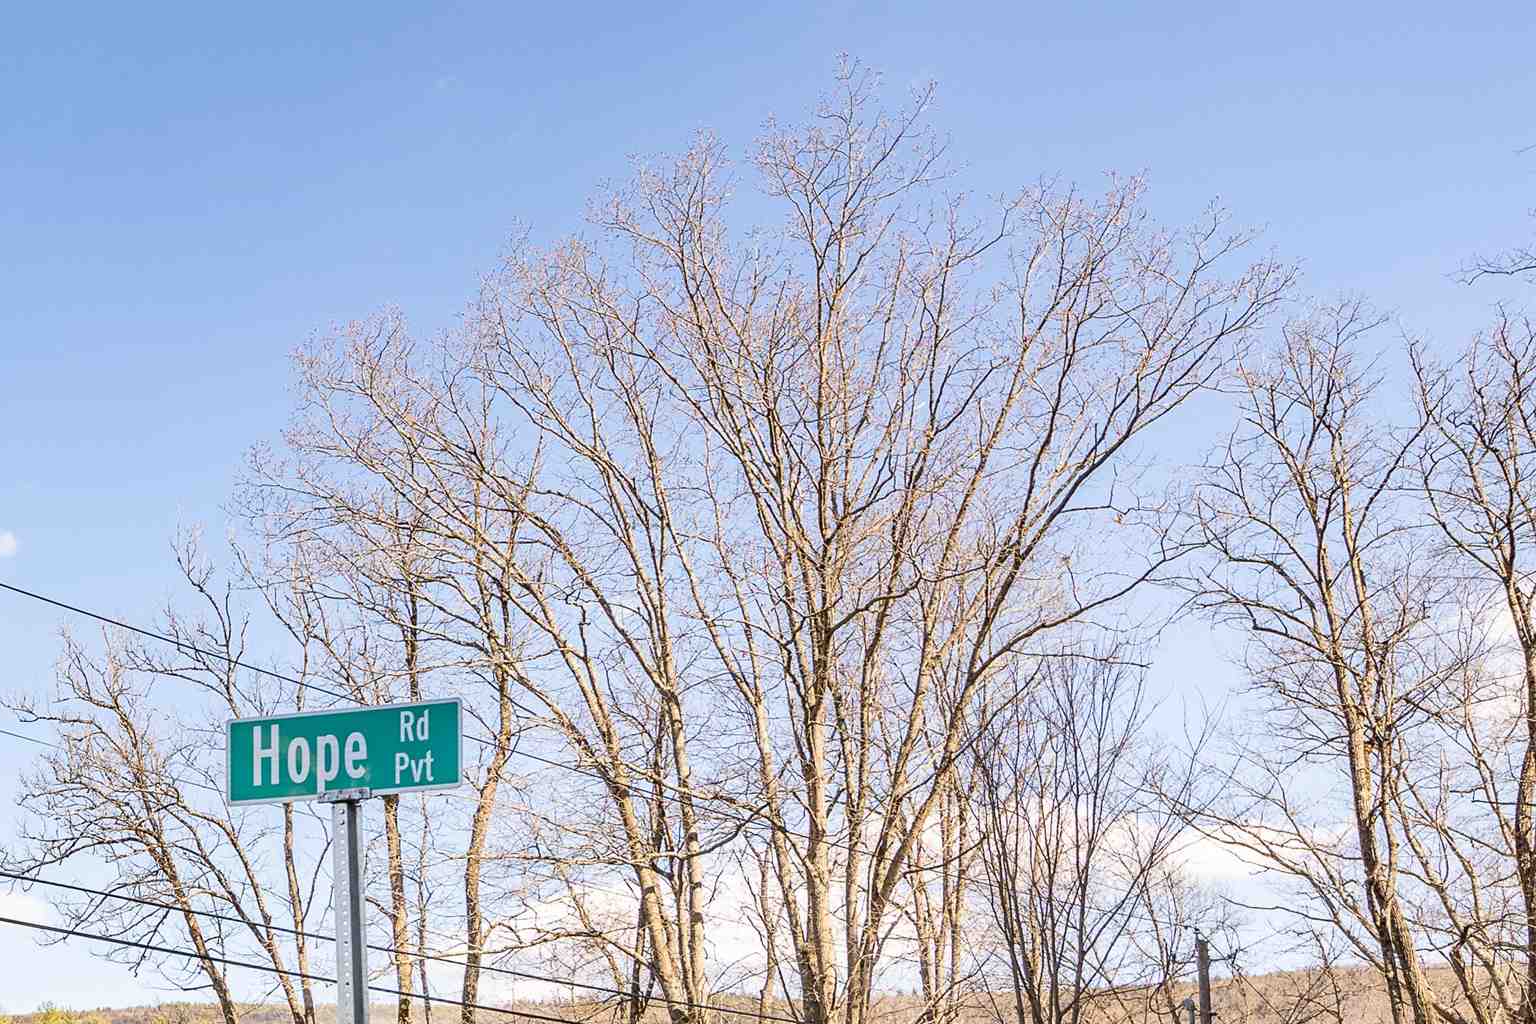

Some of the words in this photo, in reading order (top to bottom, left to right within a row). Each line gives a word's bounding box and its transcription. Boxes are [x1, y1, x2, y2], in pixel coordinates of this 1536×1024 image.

[400, 709, 430, 742] Rd
[252, 723, 368, 793] Hope
[395, 750, 434, 785] Pvt
